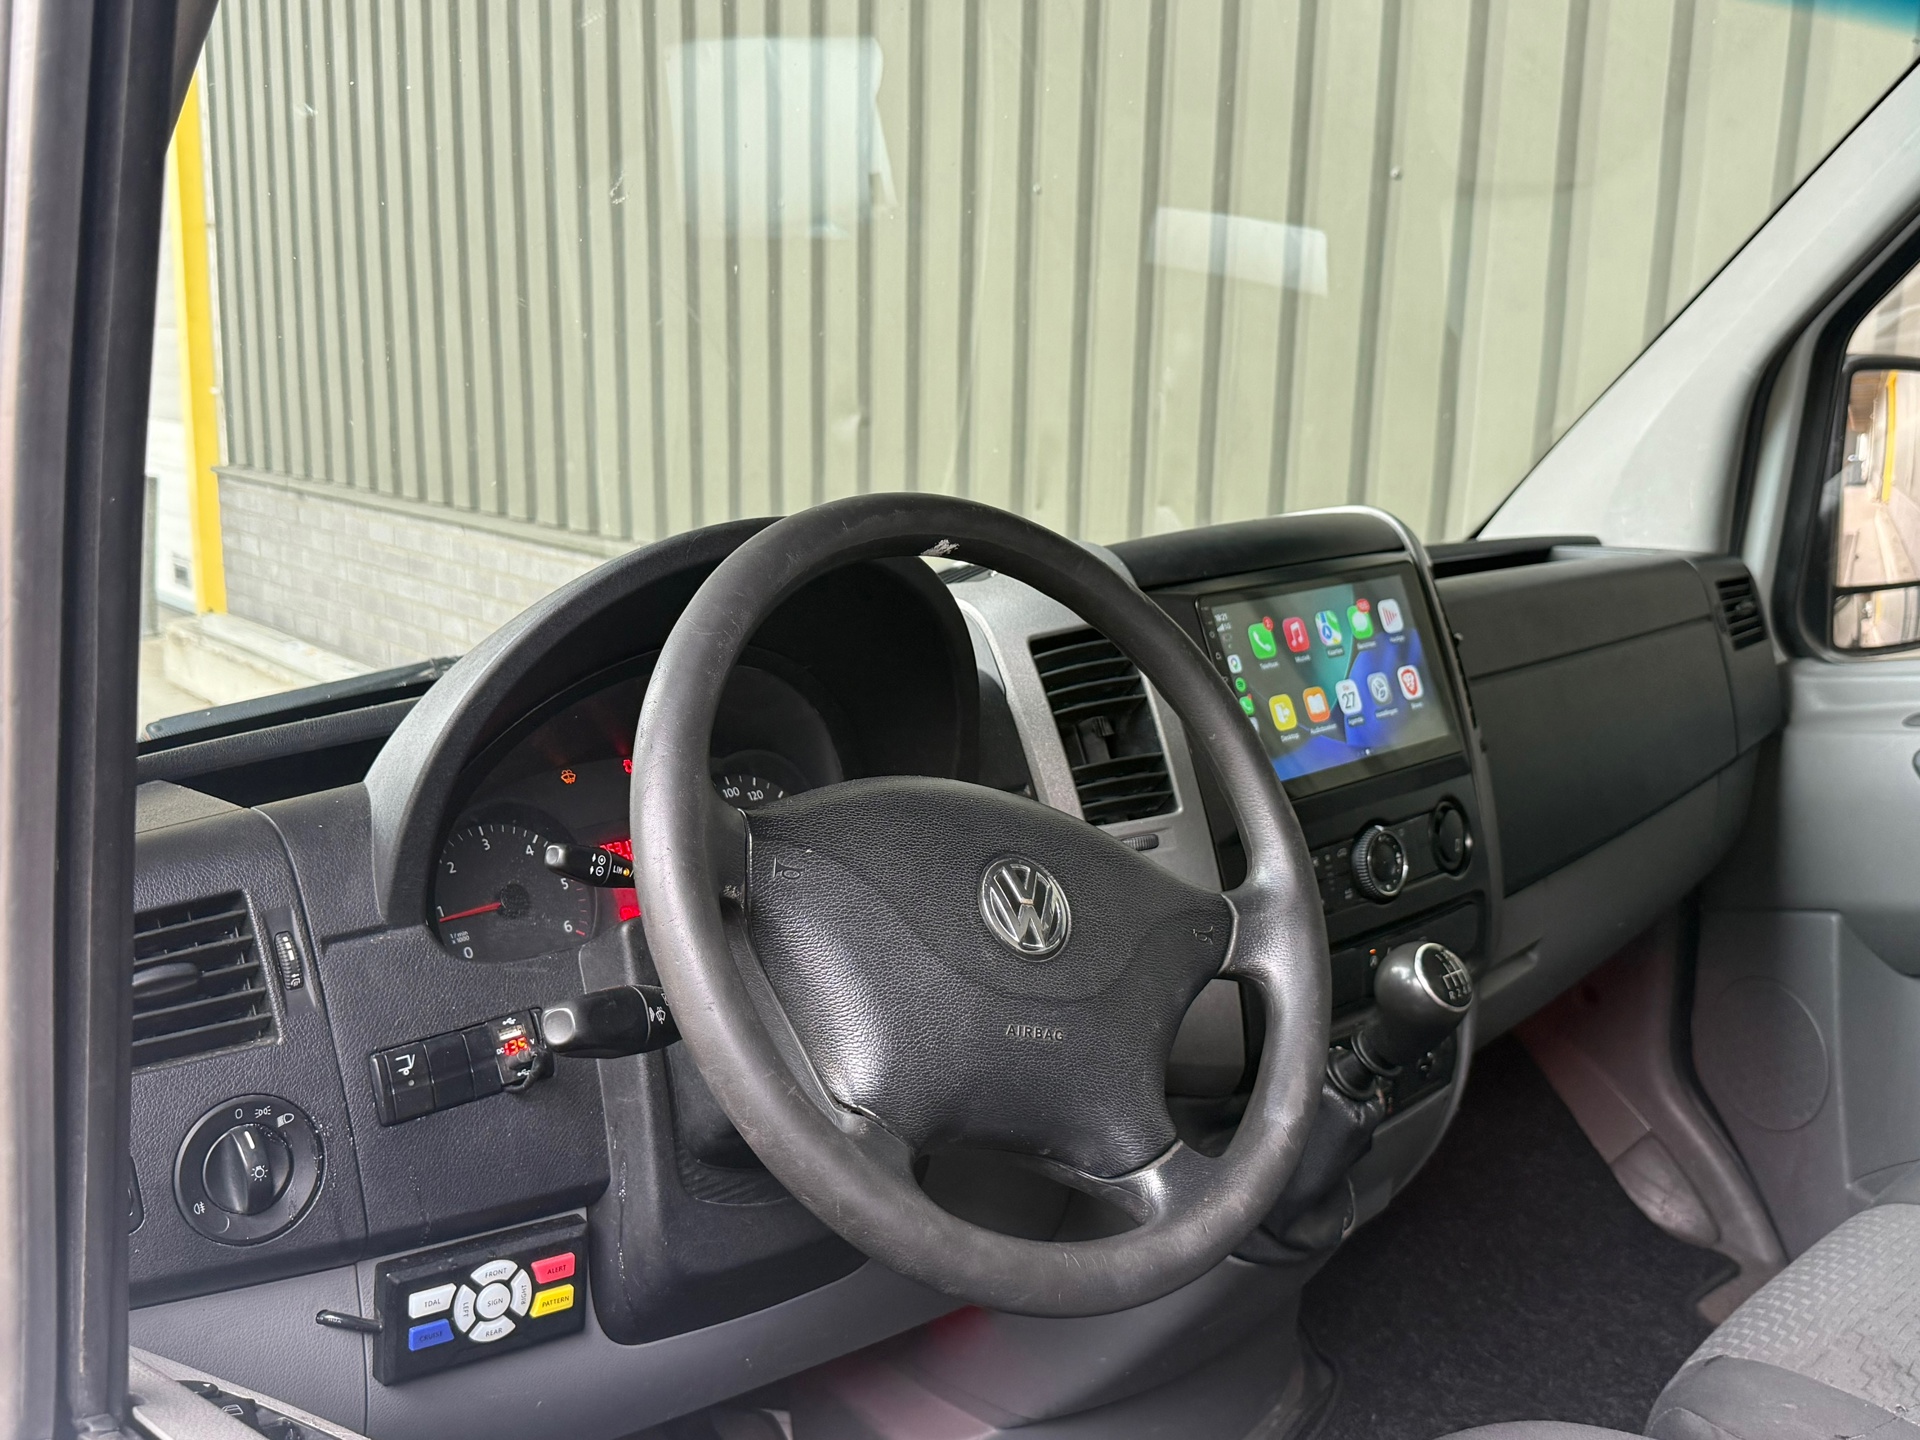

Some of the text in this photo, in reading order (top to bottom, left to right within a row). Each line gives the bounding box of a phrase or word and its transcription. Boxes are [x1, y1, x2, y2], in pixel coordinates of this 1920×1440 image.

[1342, 692, 1356, 710] 27
[722, 787, 740, 799] 100
[747, 789, 764, 802] 120
[482, 838, 491, 851] 3
[525, 844, 535, 857] 4
[447, 861, 457, 874] 2
[560, 878, 569, 890] 5
[436, 905, 445, 918] 1
[563, 920, 573, 933] 6
[463, 946, 474, 959] 0
[1449, 990, 1455, 1000] R
[1456, 988, 1462, 997] 2
[1006, 1024, 1065, 1042] AIRBAG
[484, 1267, 507, 1279] FRONT
[547, 1264, 567, 1275] ALERT
[487, 1297, 504, 1308] SIGN
[541, 1295, 570, 1308] PATTERN
[485, 1327, 503, 1338] REAR
